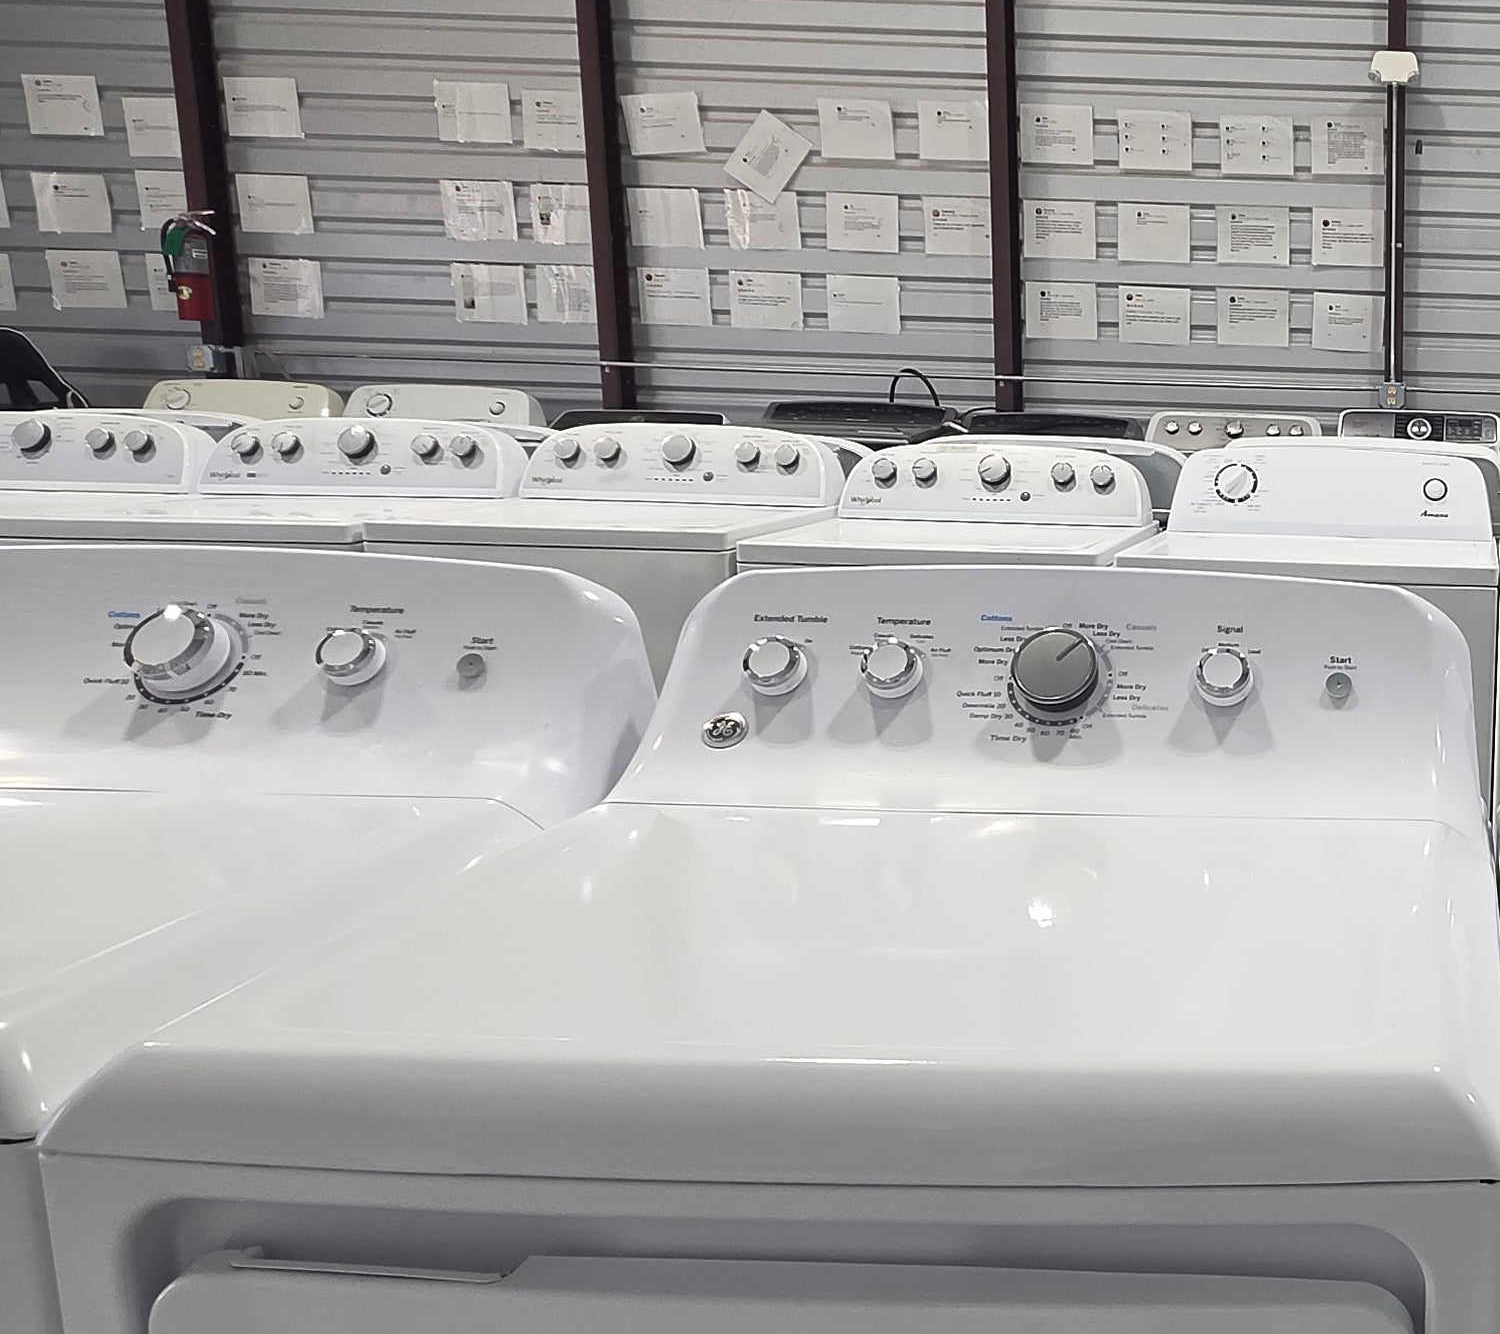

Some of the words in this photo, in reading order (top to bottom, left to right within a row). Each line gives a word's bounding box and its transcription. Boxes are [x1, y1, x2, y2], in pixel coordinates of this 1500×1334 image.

[210, 470, 241, 481] Whirlpool
[531, 476, 564, 486] Whirlpool
[850, 496, 882, 505] Whirlpool
[1420, 510, 1449, 518] Amana
[351, 605, 404, 614] Temperature
[754, 614, 795, 622] Extended
[797, 615, 828, 623] Tumble
[877, 617, 932, 626] Temperature
[1217, 625, 1244, 634] Signal
[471, 637, 494, 645] Start
[1330, 656, 1352, 664] Start
[217, 711, 232, 720] Dry
